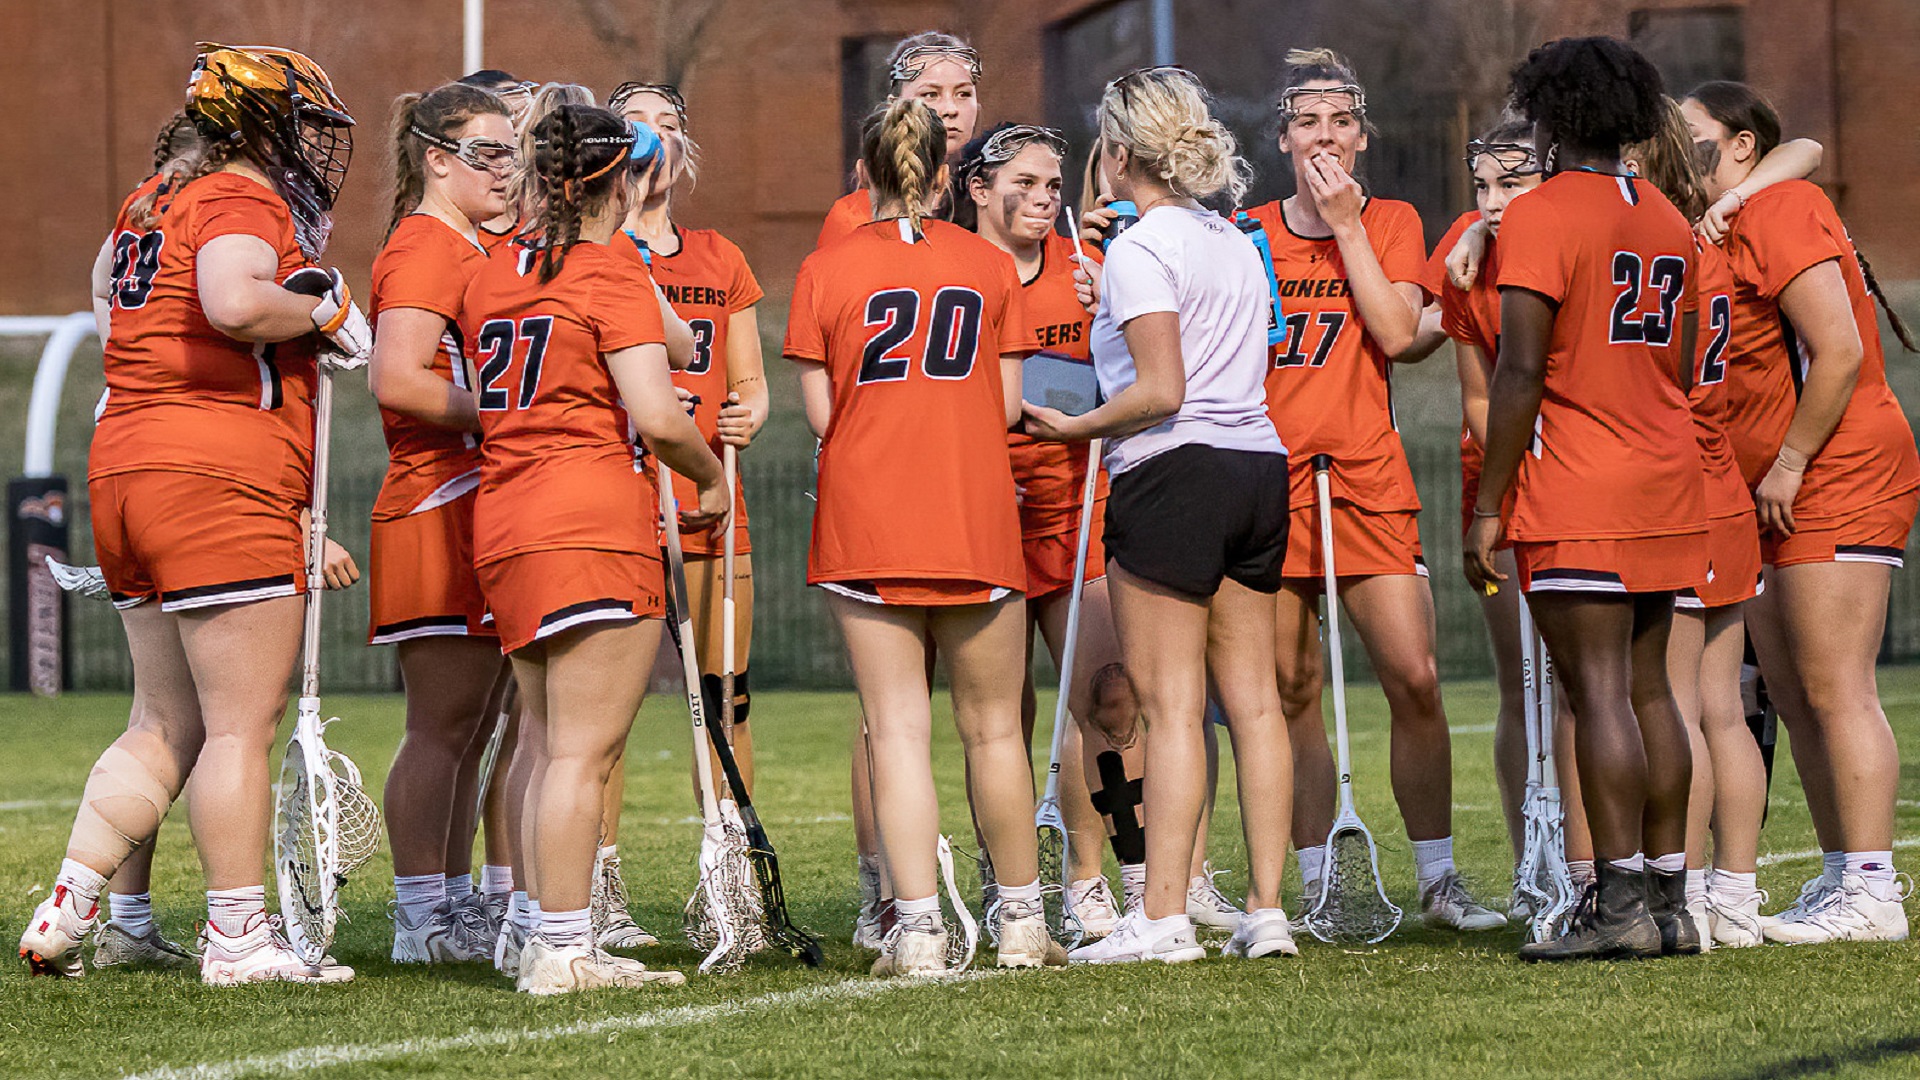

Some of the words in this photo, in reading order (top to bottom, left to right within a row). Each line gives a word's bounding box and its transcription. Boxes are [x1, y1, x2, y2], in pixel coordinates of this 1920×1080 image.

[657, 283, 727, 308] NEERS
[1608, 250, 1686, 347] 23
[478, 315, 554, 411] 27
[856, 285, 984, 386] 20
[1275, 311, 1348, 369] 17
[1699, 294, 1731, 386] 2
[690, 693, 702, 727] GAIT
[1523, 658, 1532, 689] GAIT
